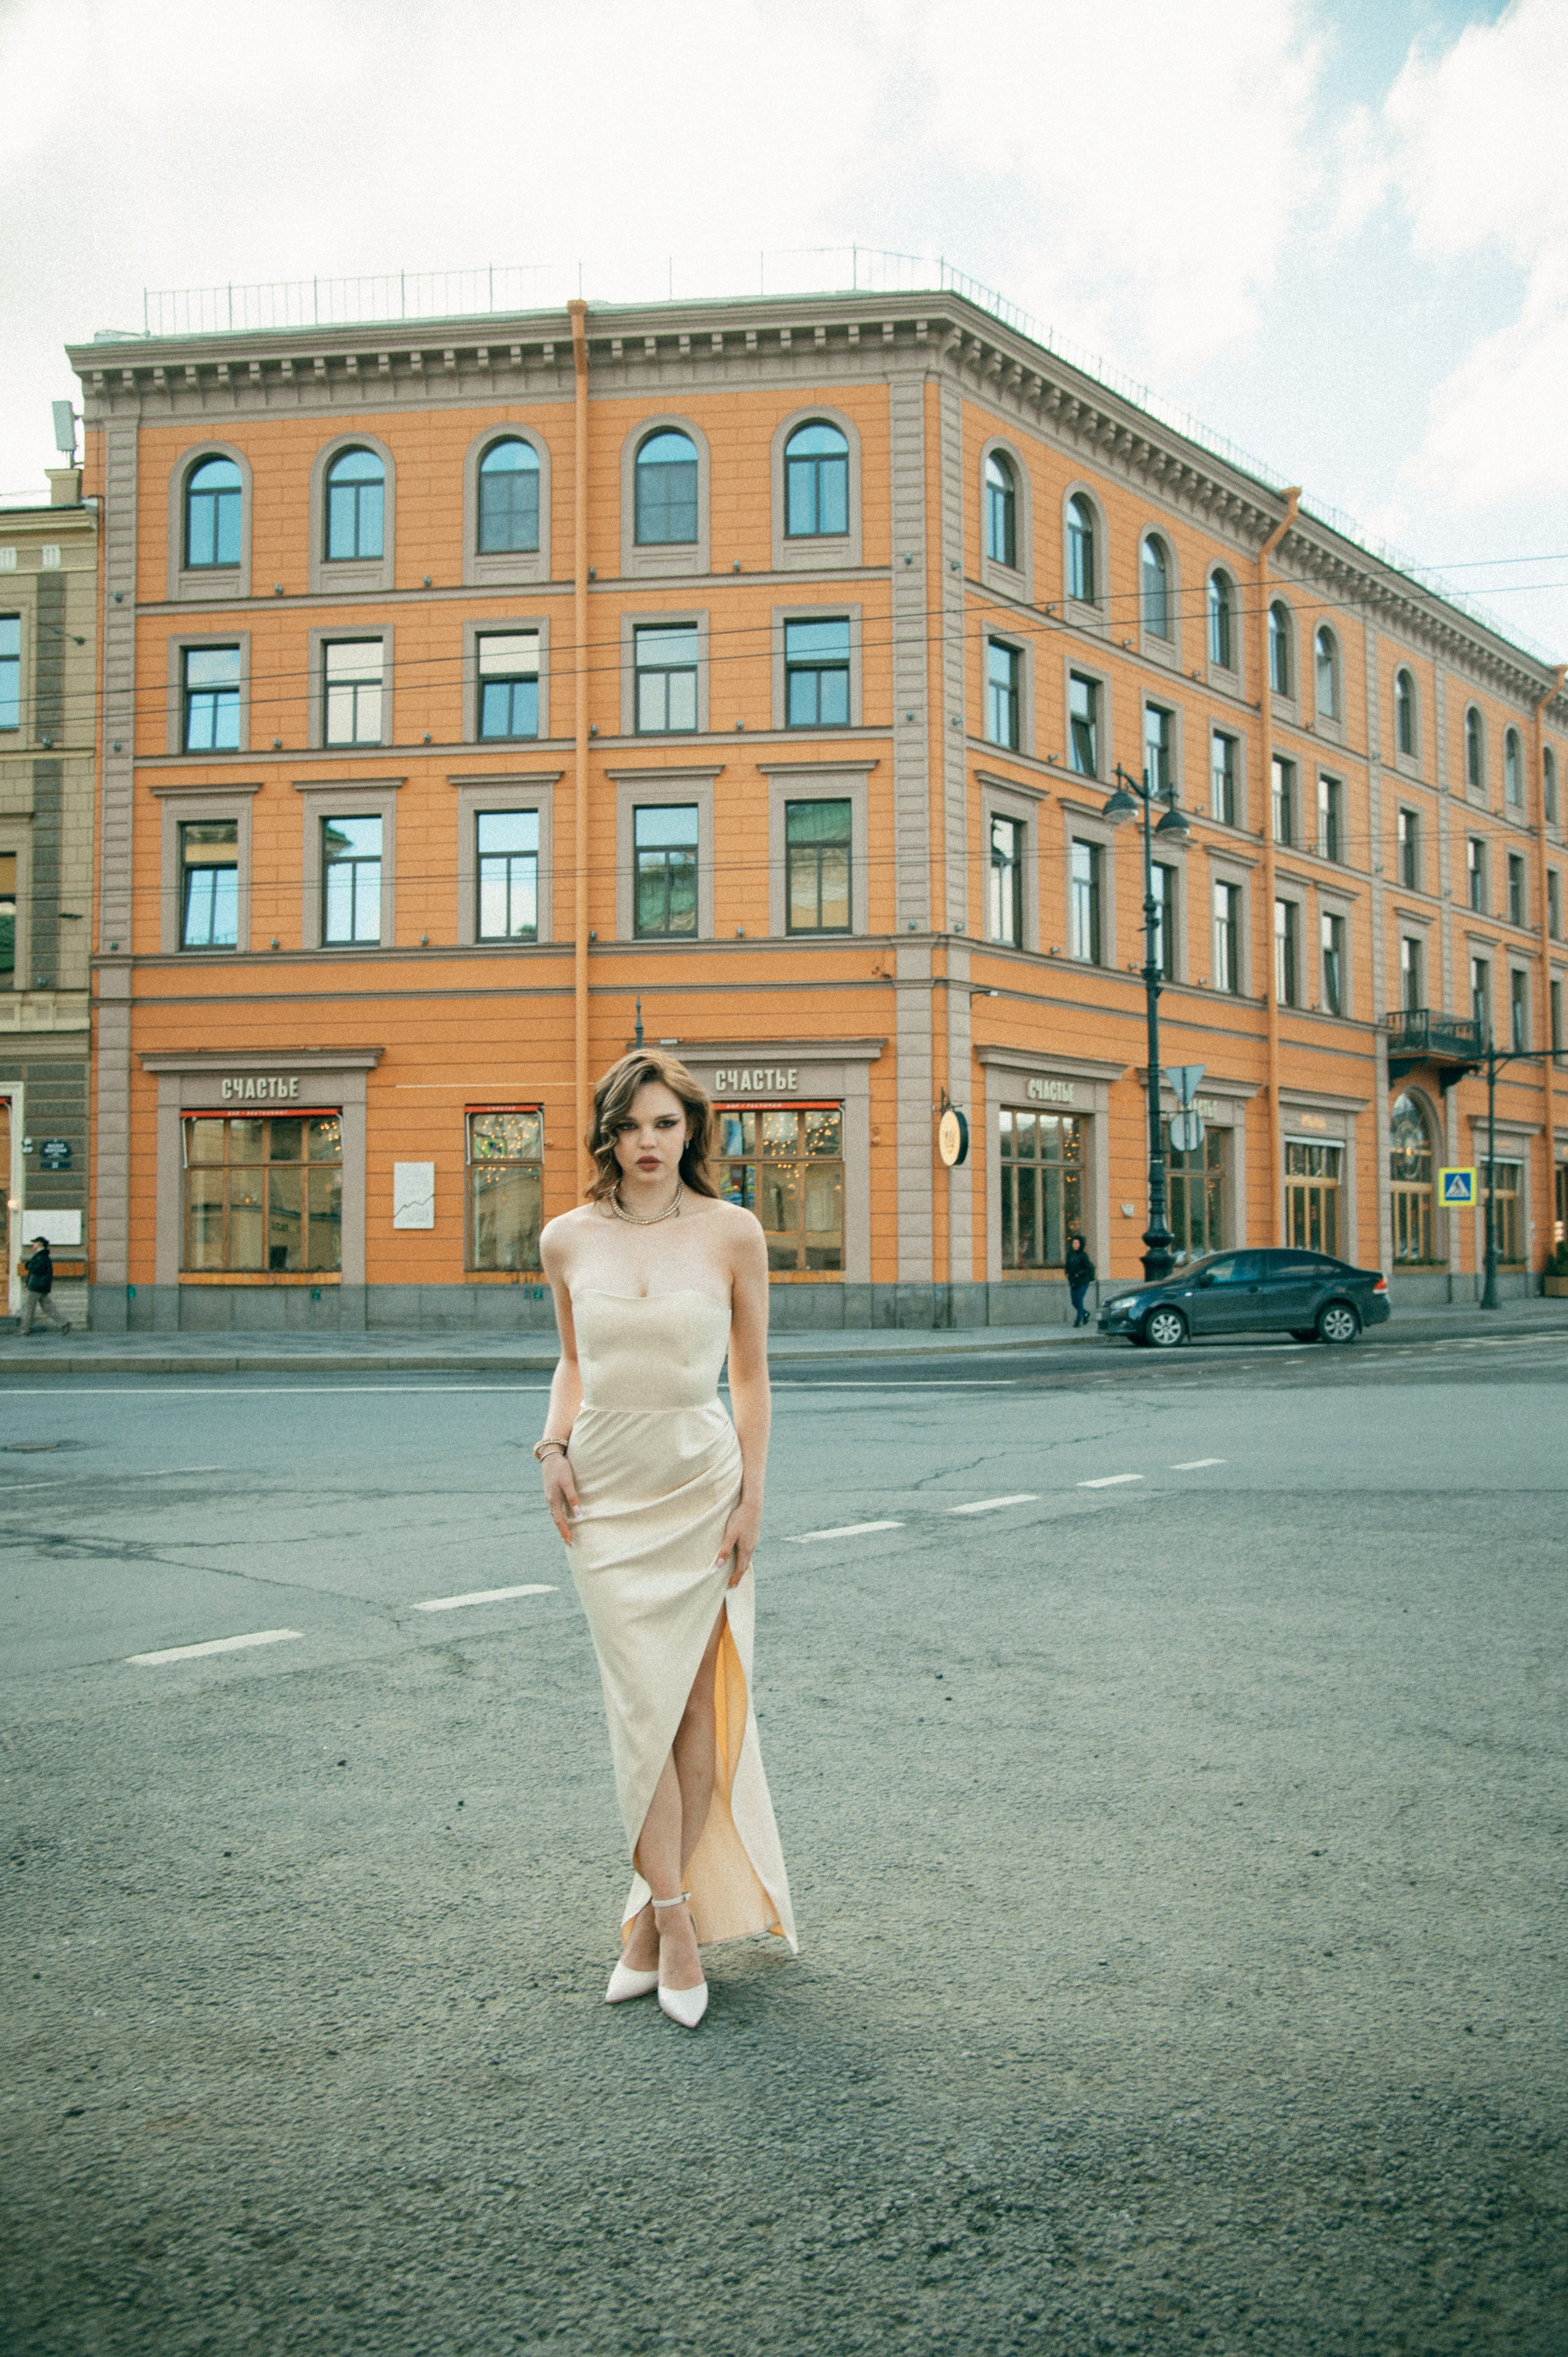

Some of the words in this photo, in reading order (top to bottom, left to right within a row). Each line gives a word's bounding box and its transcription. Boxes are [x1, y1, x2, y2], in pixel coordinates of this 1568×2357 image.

[222, 1078, 298, 1099] СЧАСТЬЕ
[715, 1069, 797, 1090] СЧАСТЬЕ
[1027, 1079, 1074, 1103] СЧАСТЬЕ
